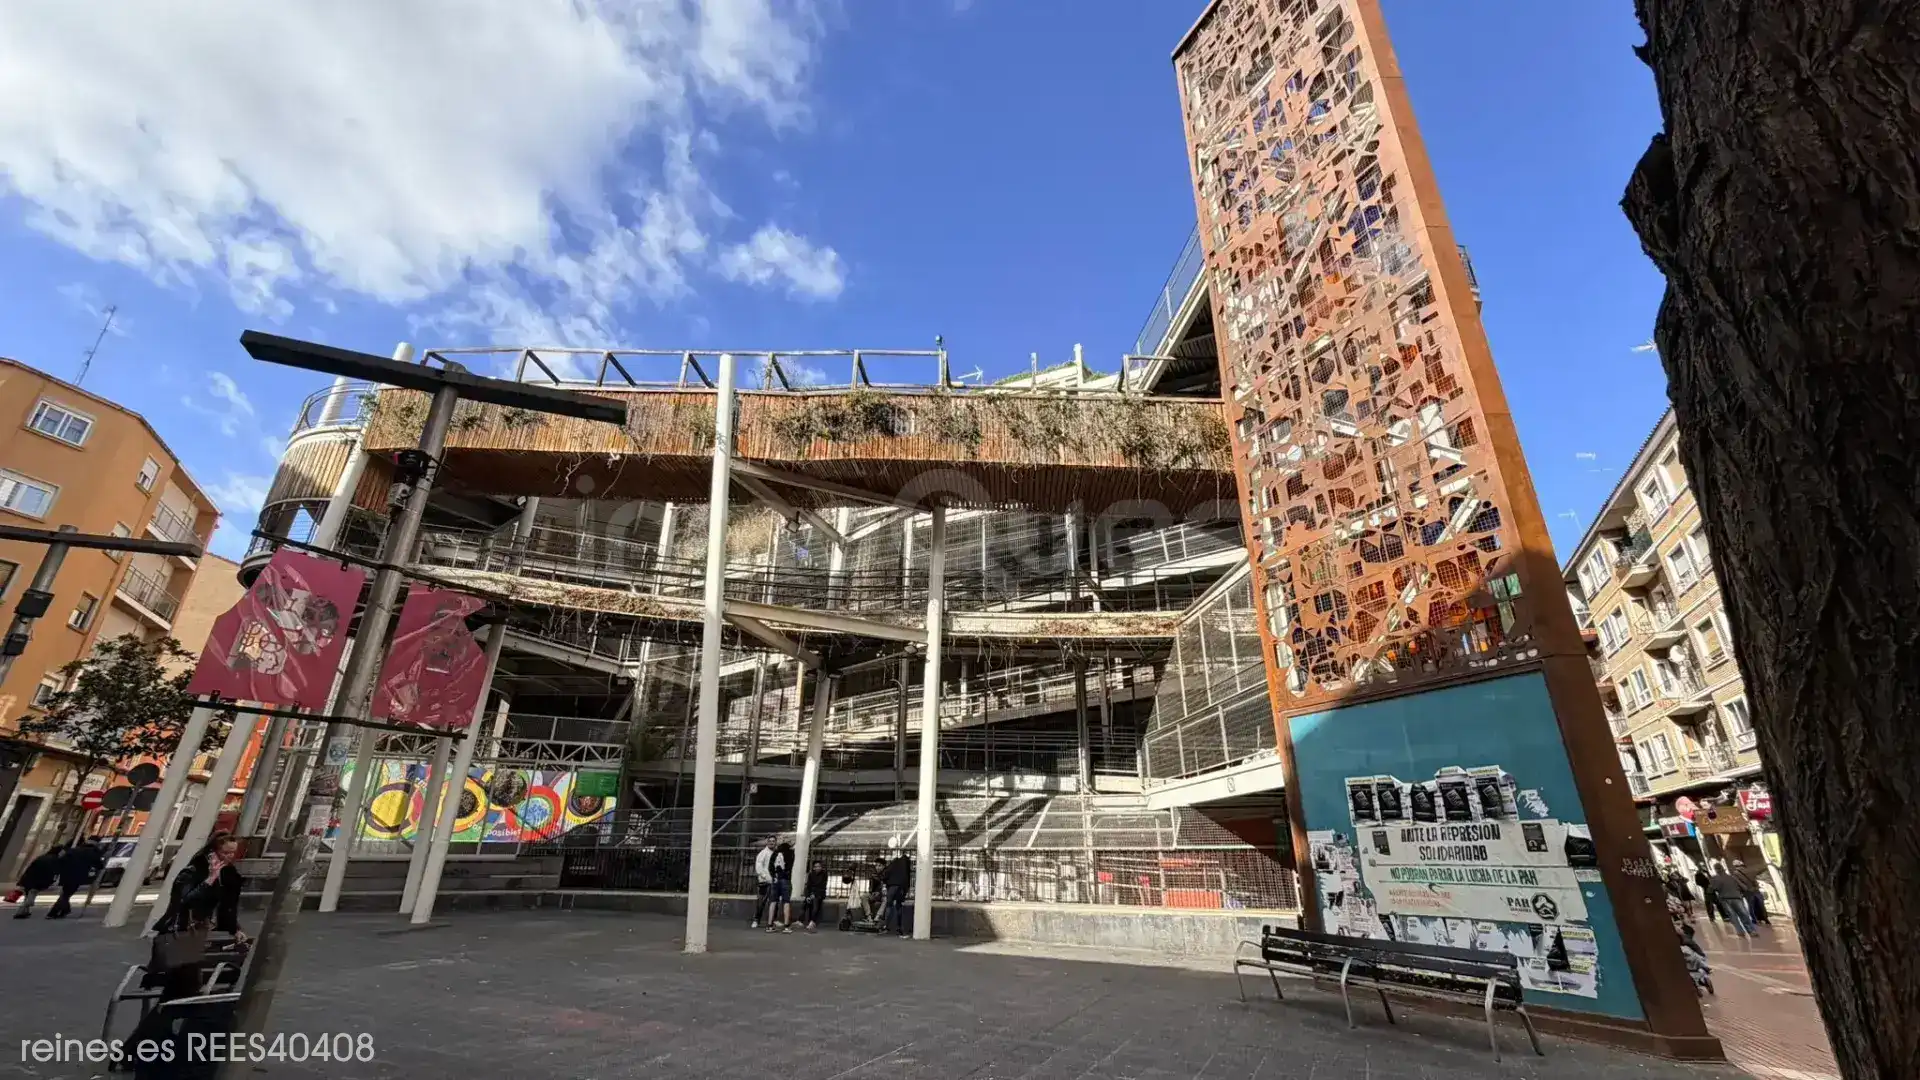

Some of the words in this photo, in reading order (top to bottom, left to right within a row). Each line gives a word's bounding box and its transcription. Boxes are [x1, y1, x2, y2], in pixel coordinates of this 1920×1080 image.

[1401, 828, 1424, 842] ANTE
[1427, 828, 1438, 842] LA
[1441, 824, 1500, 842] REPRESION
[1420, 845, 1488, 861] SOLIDARIDAD
[1390, 867, 1400, 879] NO
[1429, 868, 1454, 881] PARAR
[1454, 869, 1464, 882] LA
[1465, 868, 1492, 882] LUCHA
[1493, 869, 1505, 883] DE
[1505, 869, 1517, 884] LA
[1518, 869, 1539, 885] PAH
[1507, 897, 1530, 908] PAH
